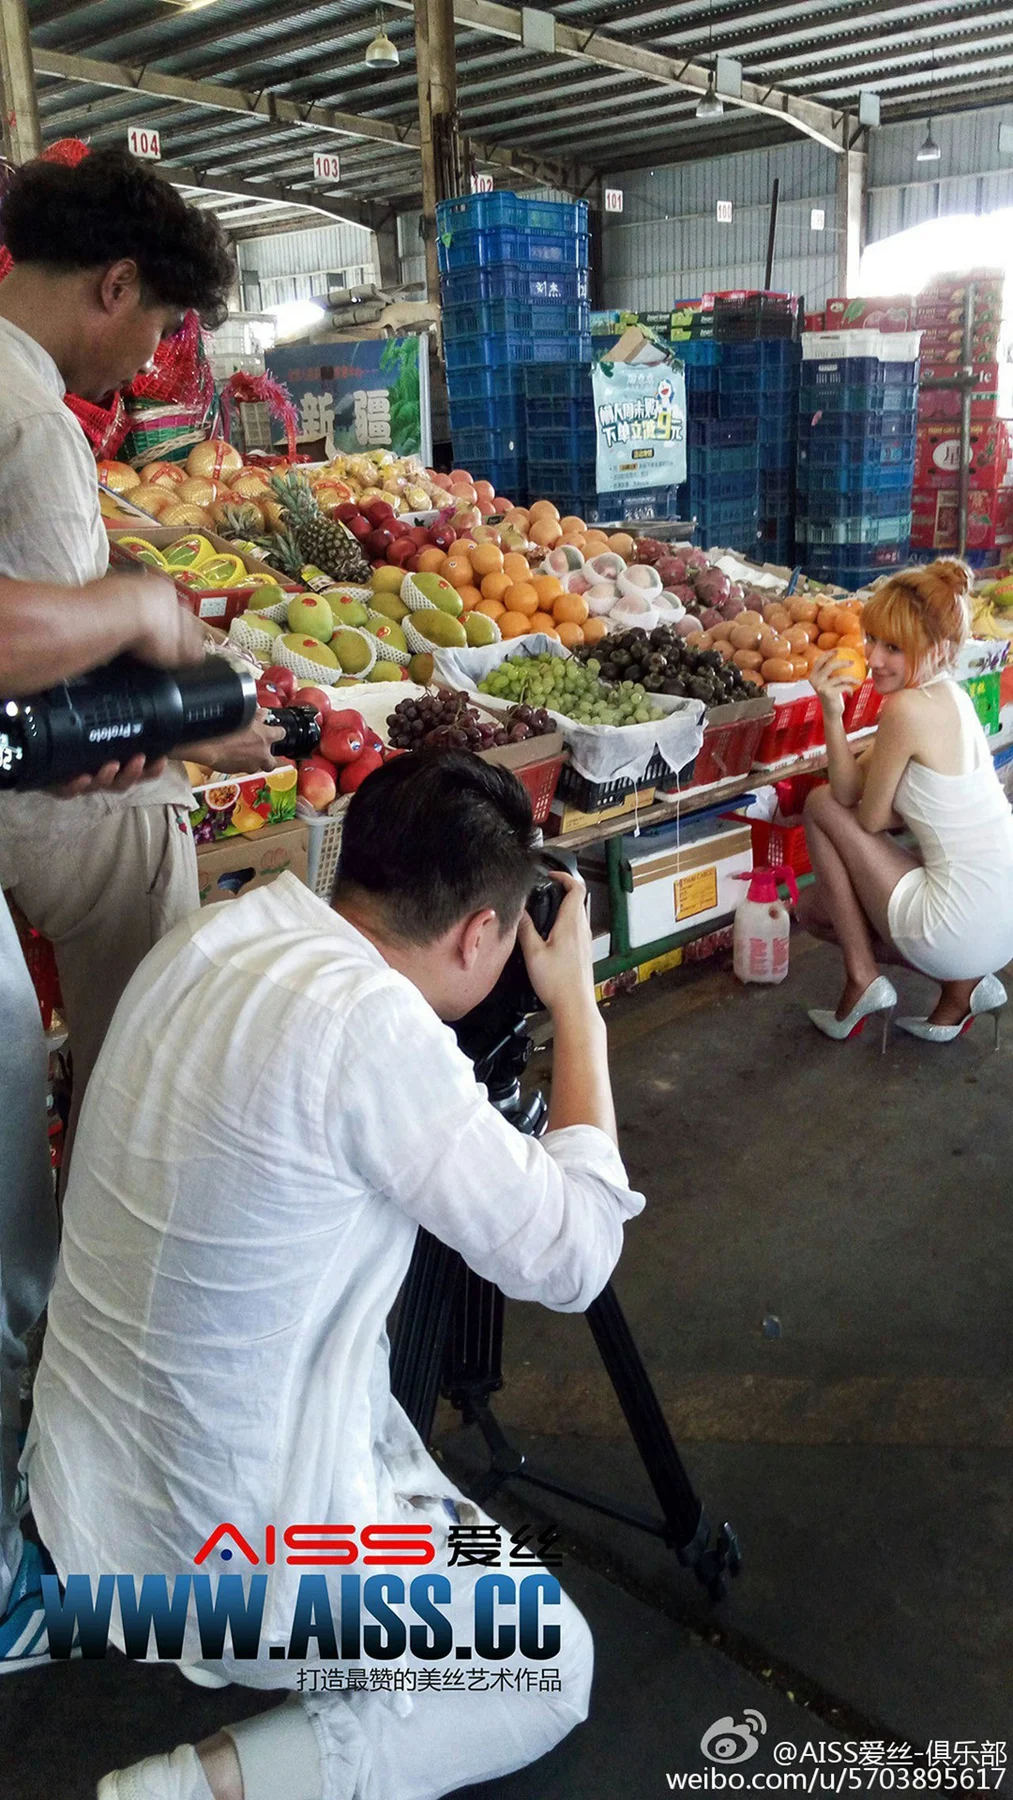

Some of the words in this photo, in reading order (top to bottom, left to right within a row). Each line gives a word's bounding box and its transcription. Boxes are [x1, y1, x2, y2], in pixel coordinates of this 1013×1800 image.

[131, 132, 159, 156] 104
[315, 156, 339, 178] 103
[474, 178, 492, 192] 102
[606, 193, 622, 210] 101
[718, 203, 732, 219] 100
[299, 388, 393, 446] 新疆
